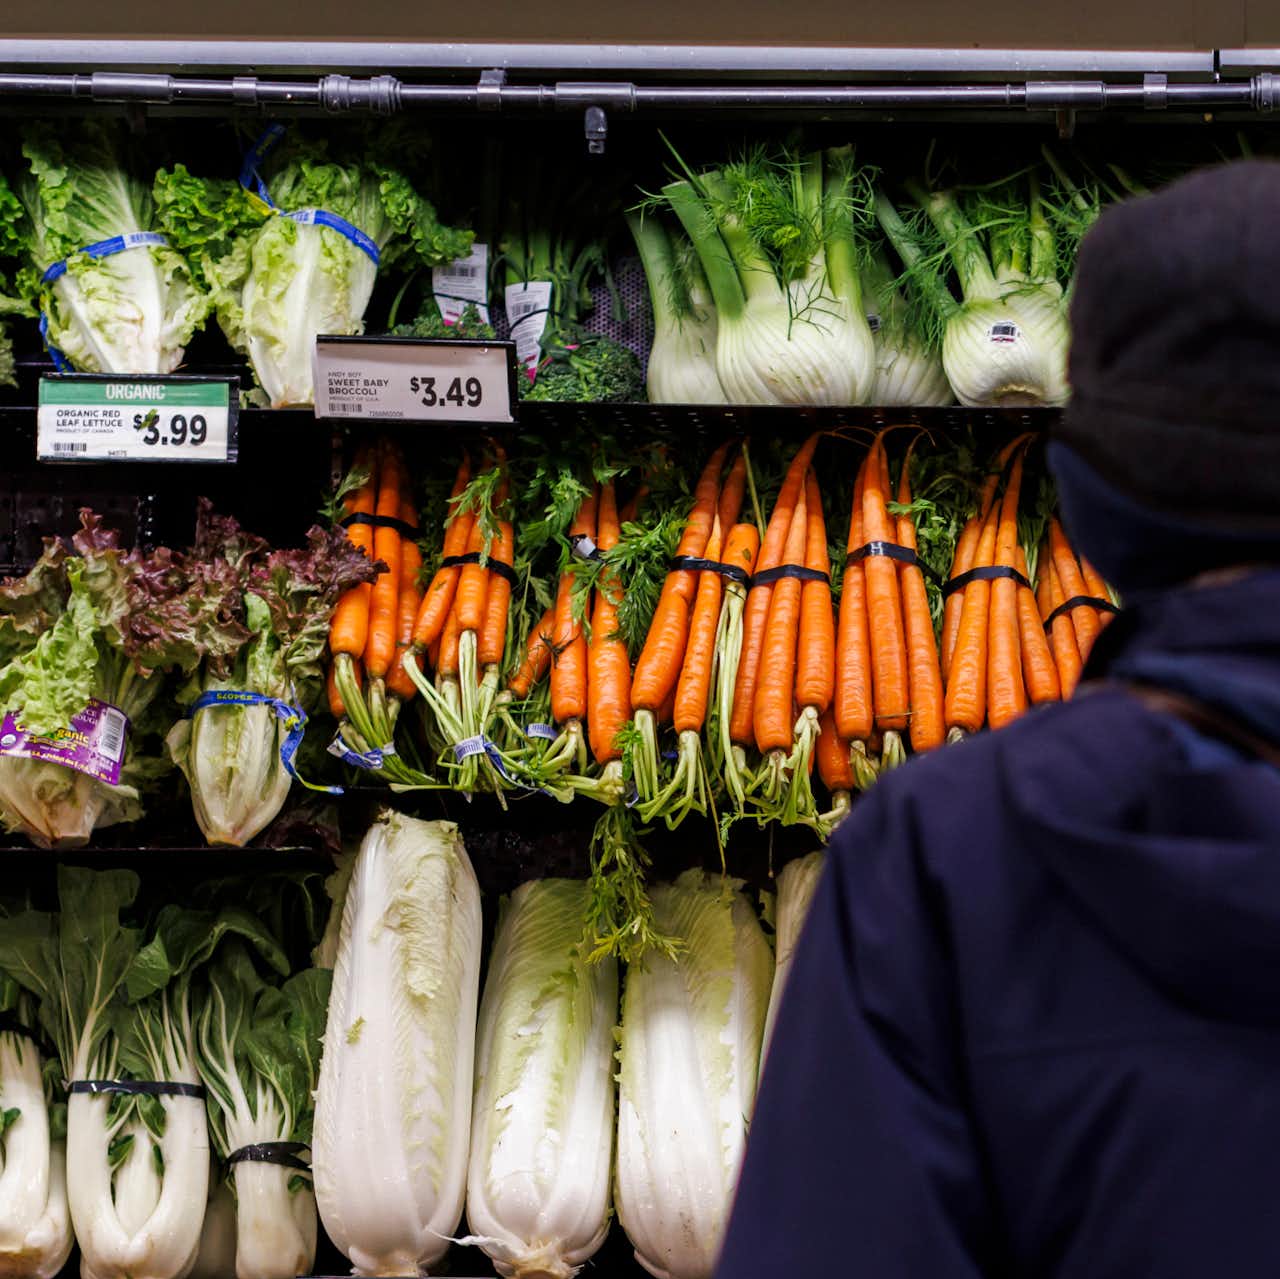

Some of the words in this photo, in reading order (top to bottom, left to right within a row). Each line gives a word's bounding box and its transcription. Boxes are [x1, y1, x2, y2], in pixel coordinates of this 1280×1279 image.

[328, 378, 360, 386] SWEET
[363, 379, 389, 387] BABY
[106, 384, 166, 400] ORGANIC
[328, 387, 377, 395] BROCCOLI
[410, 376, 482, 407] $3.49
[56, 409, 99, 418] ORGANIC
[102, 409, 121, 418] RED
[56, 418, 80, 427] LEAF
[82, 418, 123, 427] LETTUCE
[133, 413, 207, 446] $3.99
